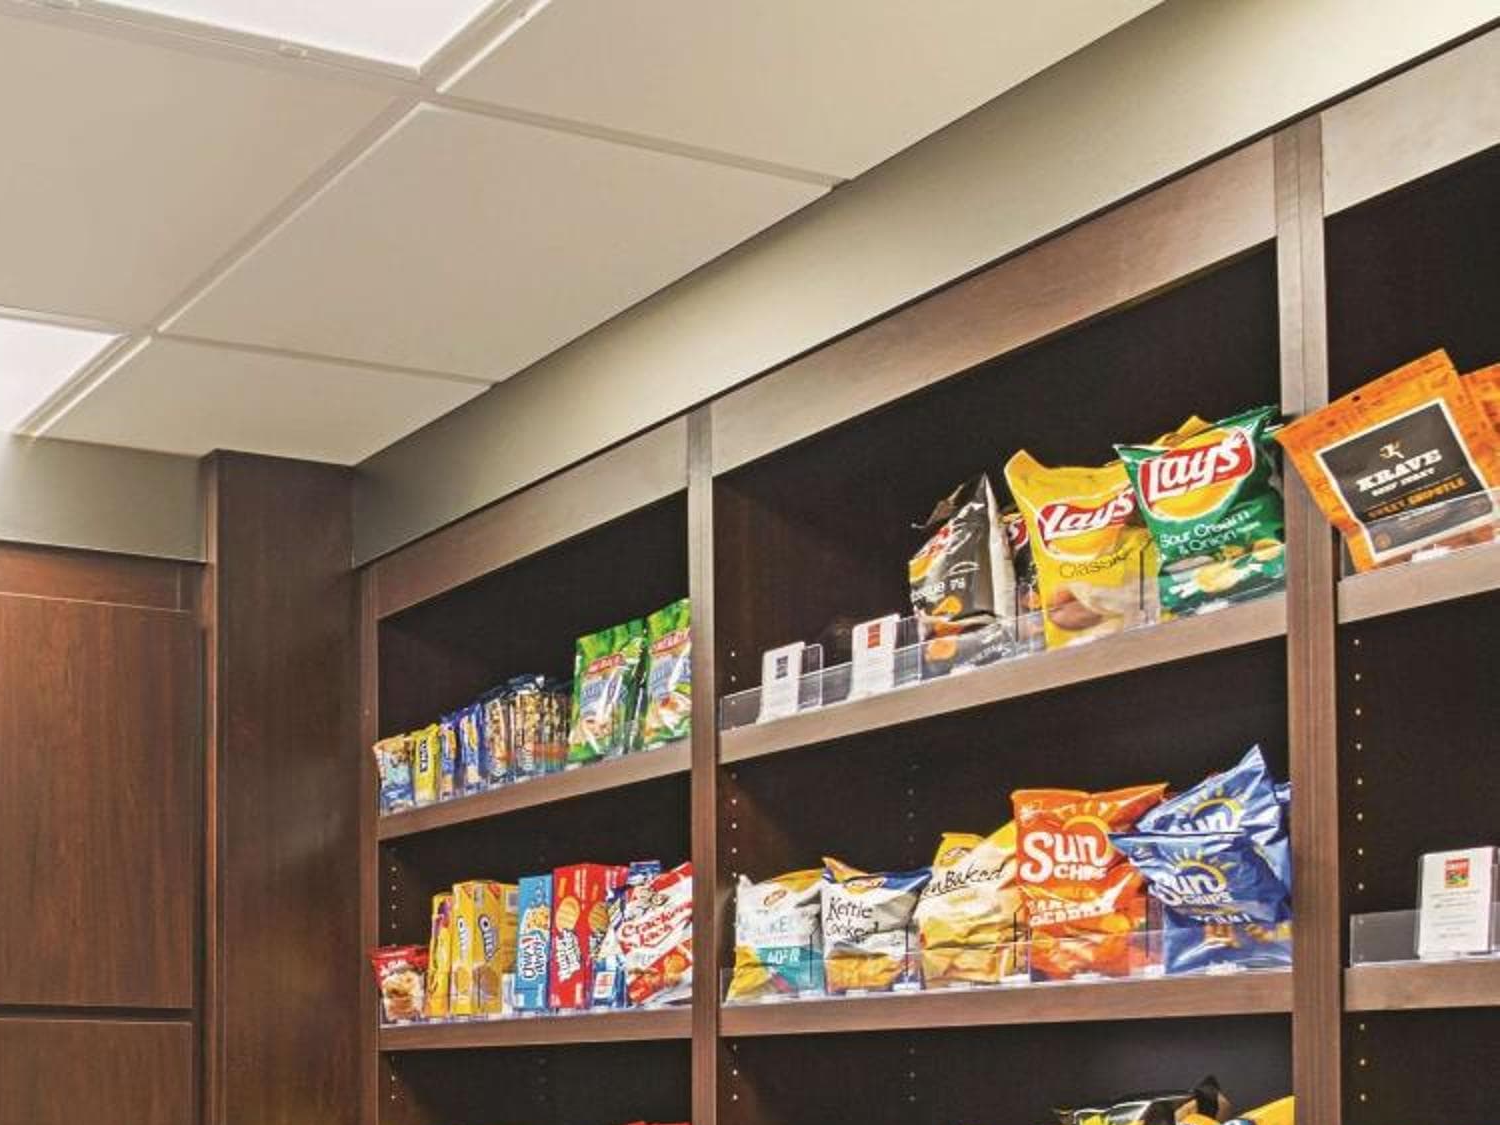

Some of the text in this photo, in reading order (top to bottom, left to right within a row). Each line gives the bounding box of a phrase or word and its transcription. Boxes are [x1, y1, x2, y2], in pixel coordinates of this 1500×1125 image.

[1148, 432, 1247, 503] Lay's
[1355, 448, 1443, 493] KRAVE
[1159, 509, 1250, 547] Sour Cream
[1191, 528, 1237, 552] Onion
[1019, 831, 1113, 883] Sun
[1148, 869, 1227, 907] Sun
[826, 896, 873, 921] Kettle
